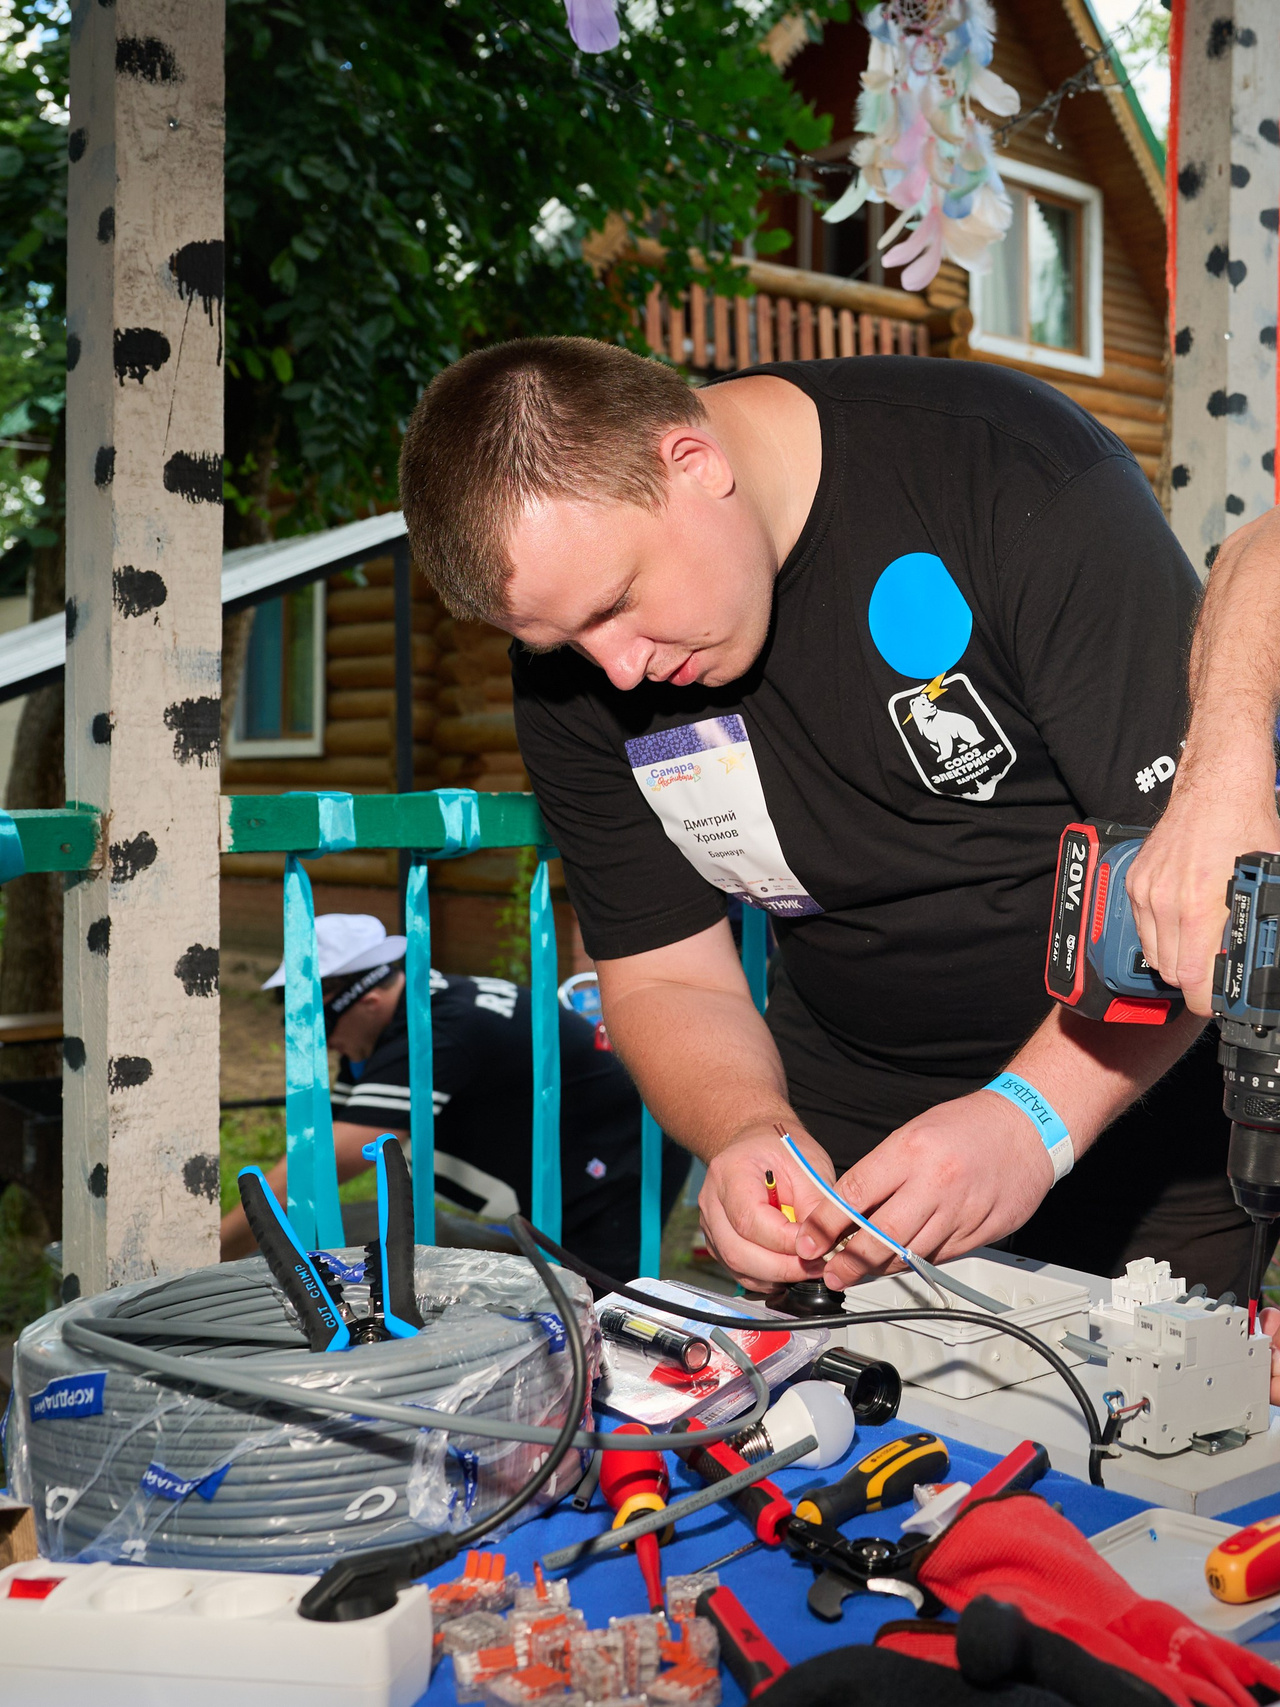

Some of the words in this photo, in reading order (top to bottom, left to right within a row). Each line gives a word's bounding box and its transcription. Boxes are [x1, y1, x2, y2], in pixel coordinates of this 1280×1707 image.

[931, 744, 1004, 784] ЭЛЕКТРИКОВ
[944, 748, 981, 770] СОЮЗ
[651, 762, 694, 779] Самара
[955, 765, 990, 785] БАРНАУЛ
[683, 810, 737, 832] Дмитрий
[693, 829, 739, 844] Хромов
[708, 849, 745, 859] Барнаул
[1067, 842, 1086, 906] 20V
[1252, 1076, 1259, 1087] 8
[1001, 1079, 1052, 1125] ЛАДЬЯ
[295, 1265, 320, 1298] CRIMP
[317, 1306, 336, 1328] CUT
